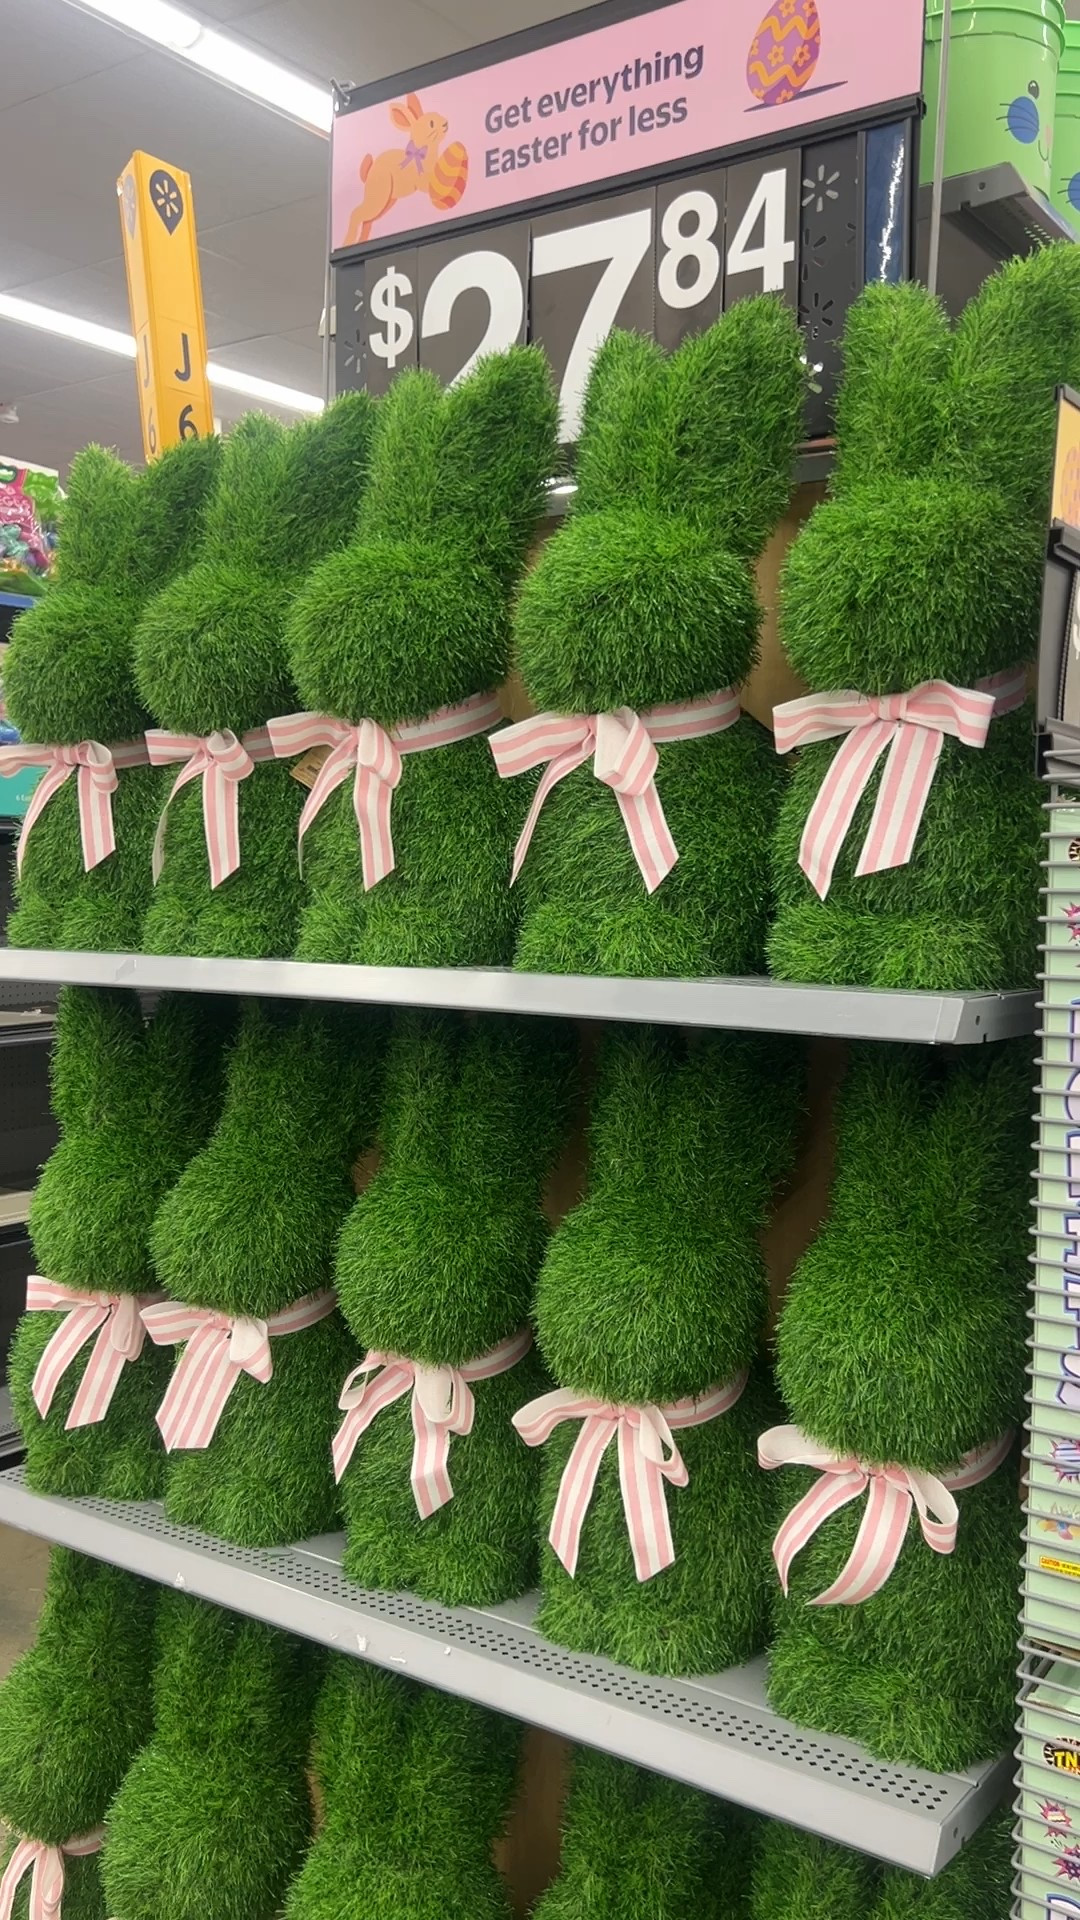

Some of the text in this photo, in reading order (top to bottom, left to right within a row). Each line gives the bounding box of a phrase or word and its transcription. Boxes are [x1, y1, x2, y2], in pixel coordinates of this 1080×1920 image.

[485, 45, 704, 133] Get everything
[485, 97, 688, 178] Easter for less
[174, 332, 191, 382] J
[1054, 1751, 1080, 1768] TN
